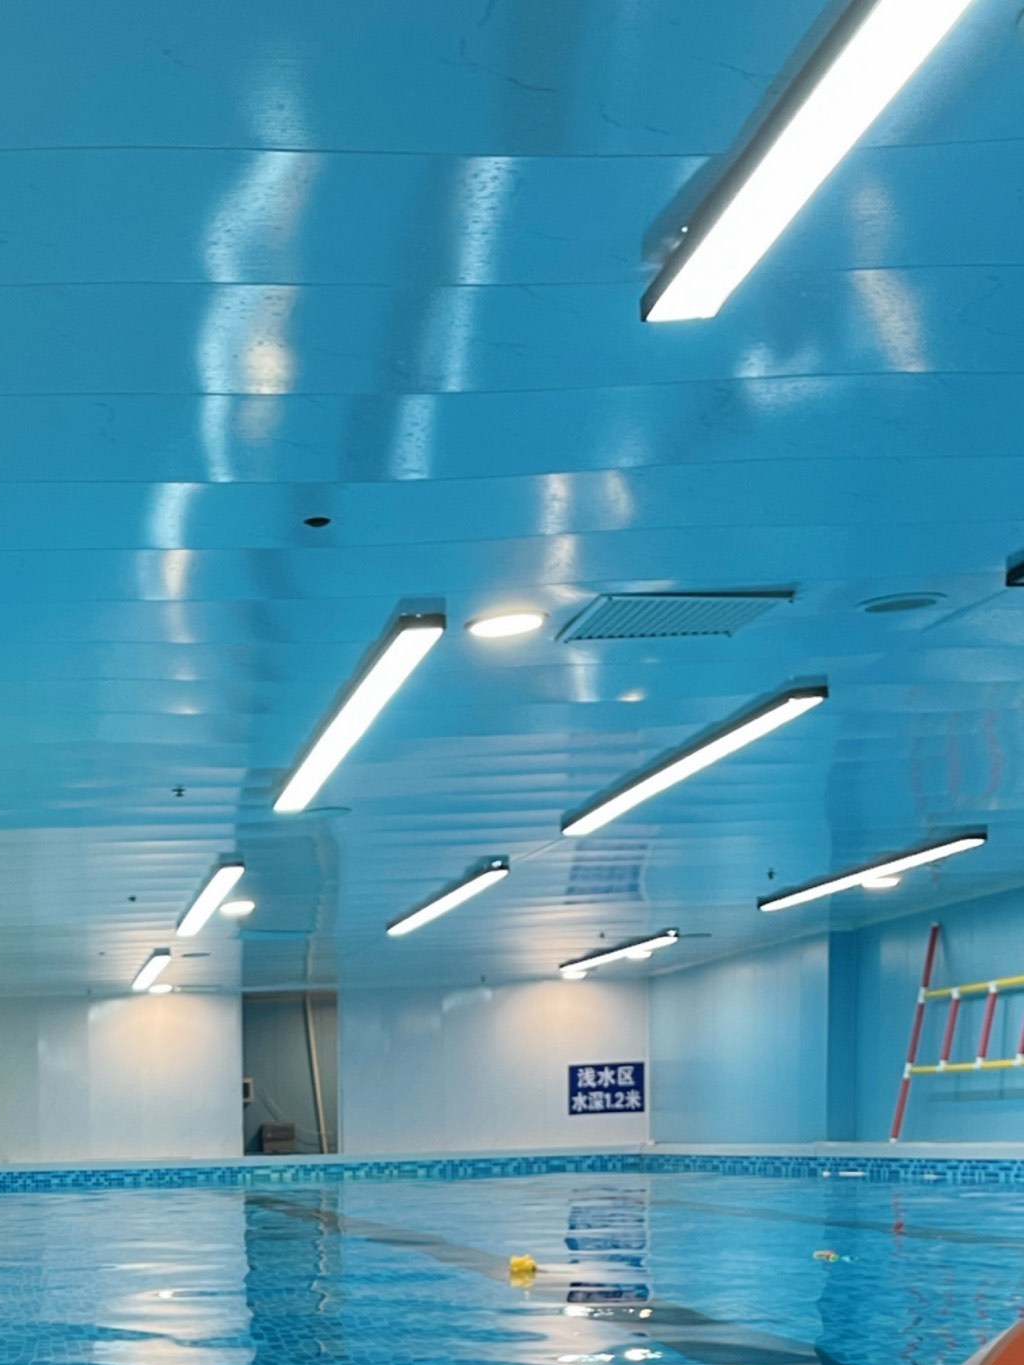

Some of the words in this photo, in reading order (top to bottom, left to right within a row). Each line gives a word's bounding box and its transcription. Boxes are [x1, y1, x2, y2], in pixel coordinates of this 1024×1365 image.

[577, 1066, 636, 1088] 浅水区
[572, 1090, 642, 1112] 水深1.2米
